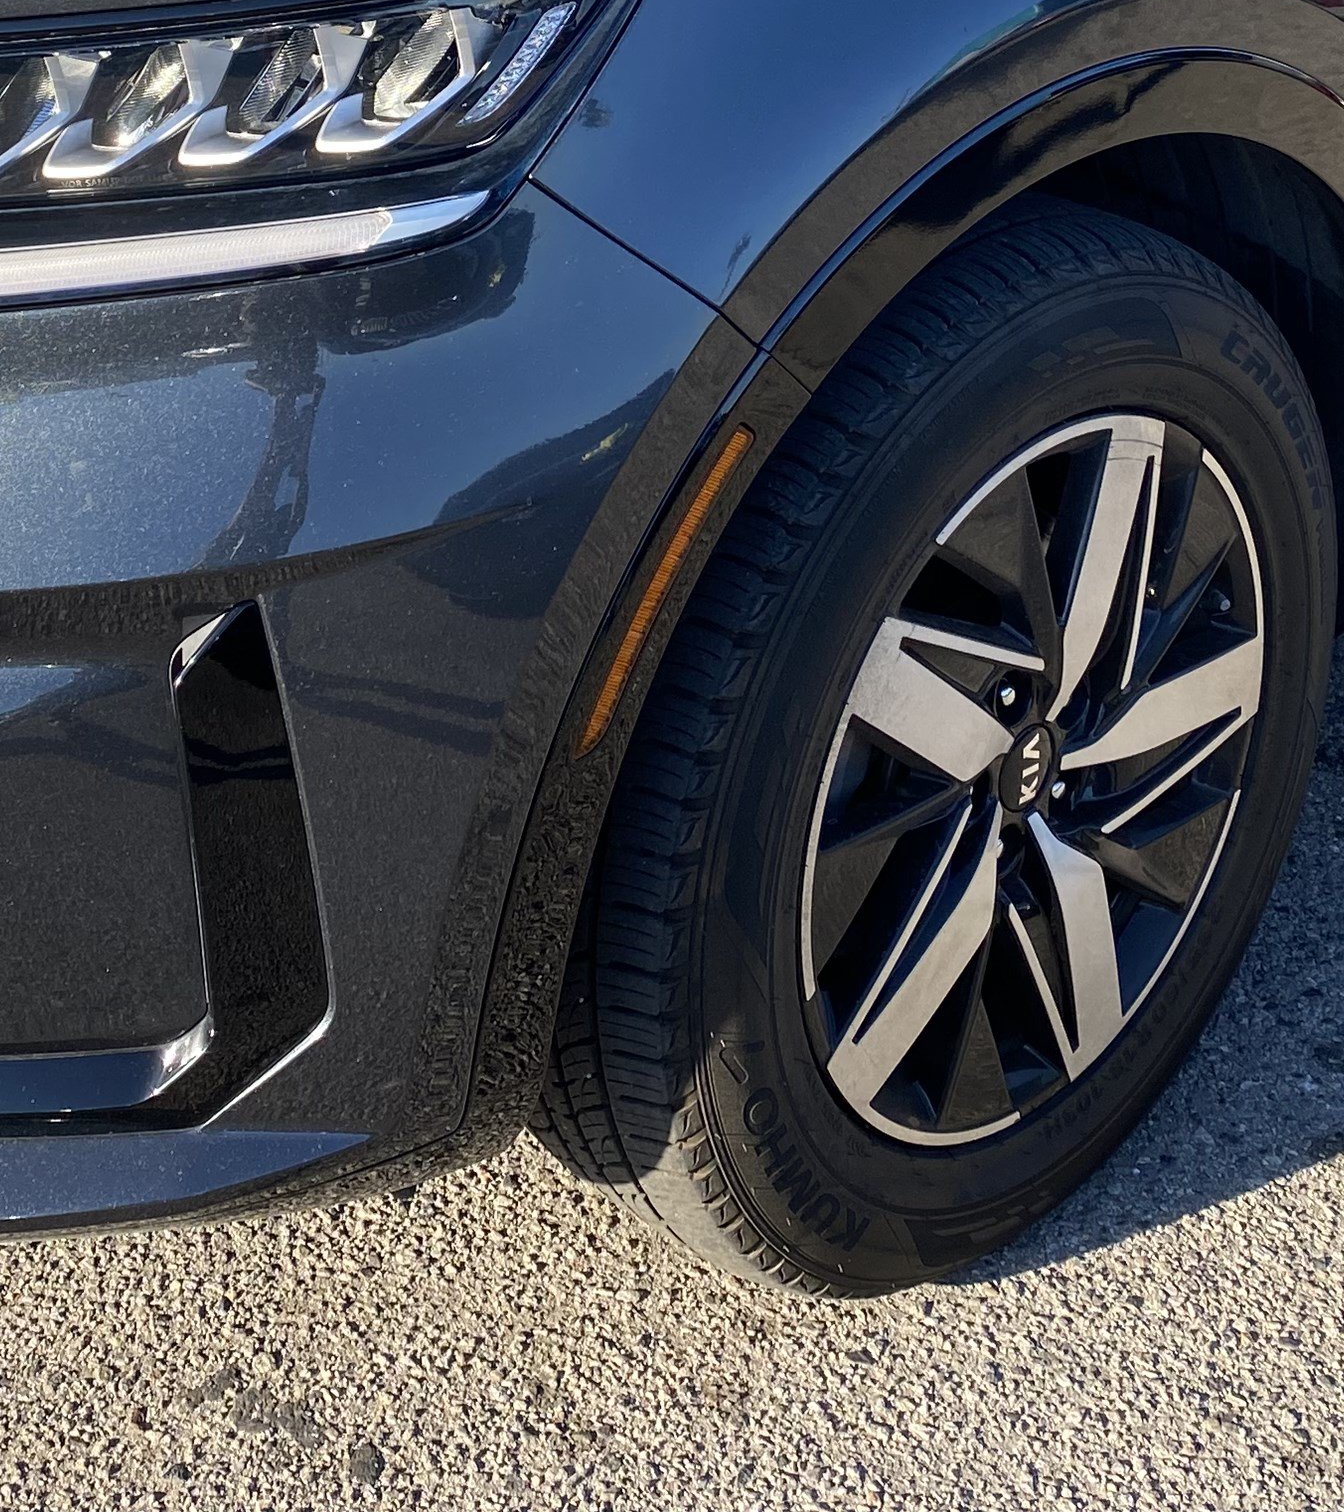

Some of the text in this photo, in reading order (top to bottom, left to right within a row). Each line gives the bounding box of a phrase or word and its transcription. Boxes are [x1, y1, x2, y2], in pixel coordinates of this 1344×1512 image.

[1219, 327, 1326, 522] CRUGEN
[1018, 732, 1040, 806] KIA
[740, 1073, 874, 1260] KUMHO
